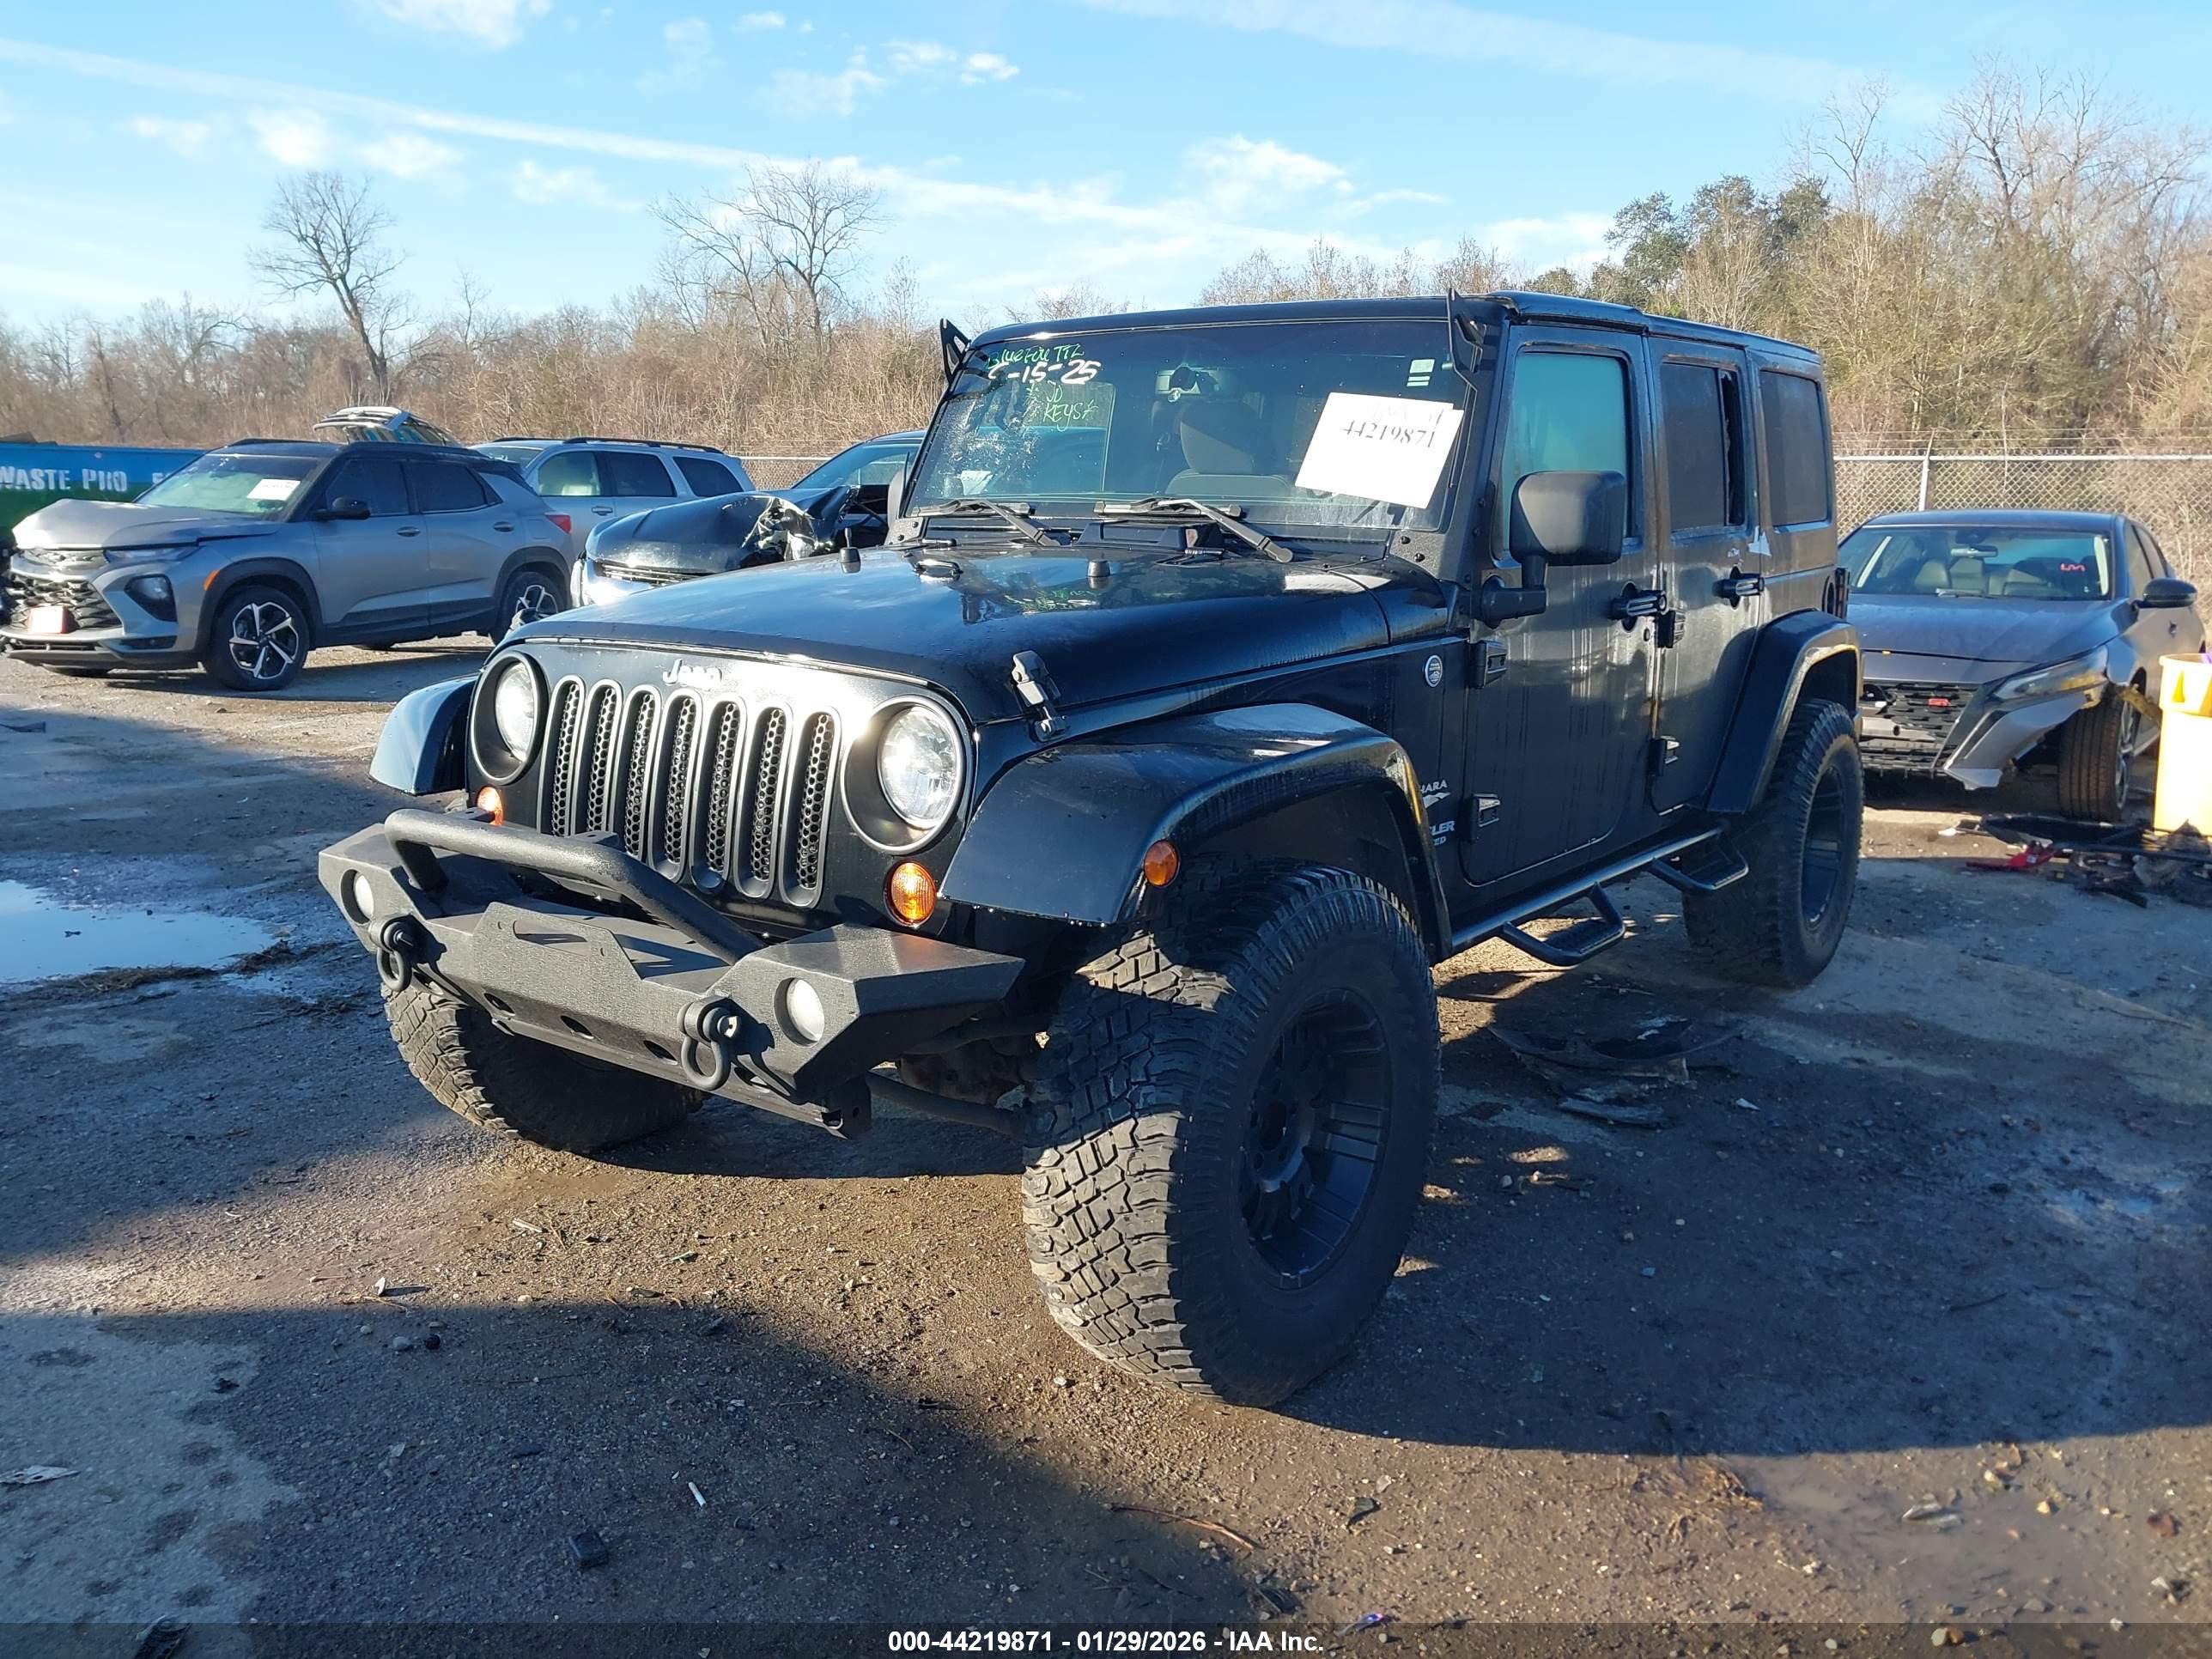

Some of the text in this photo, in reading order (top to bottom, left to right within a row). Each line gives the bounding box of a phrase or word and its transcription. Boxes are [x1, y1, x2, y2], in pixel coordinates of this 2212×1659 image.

[1341, 419, 1436, 448] 44219871
[0, 465, 71, 490] WASTE
[1420, 780, 1448, 793] HARA
